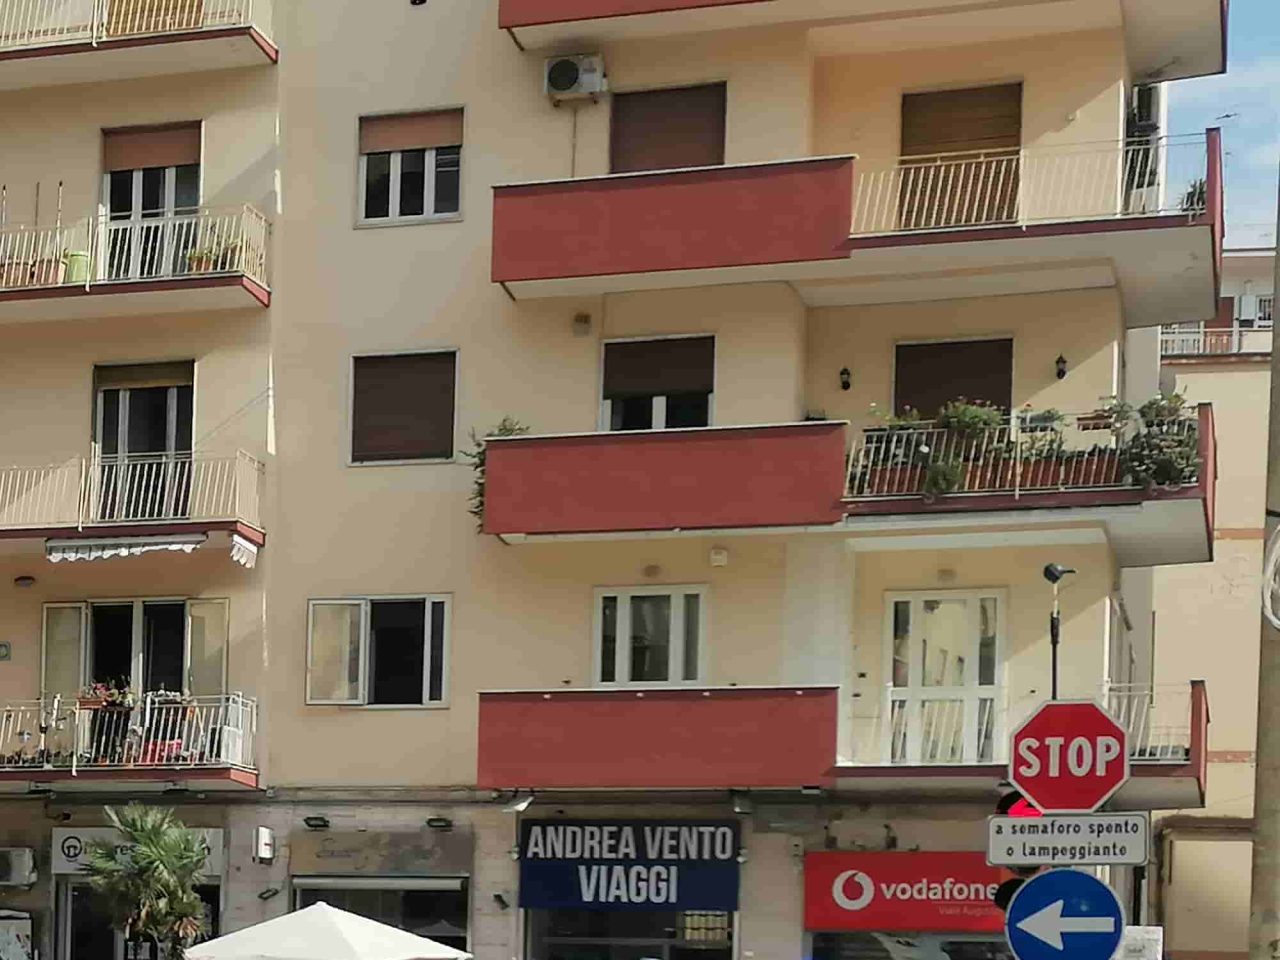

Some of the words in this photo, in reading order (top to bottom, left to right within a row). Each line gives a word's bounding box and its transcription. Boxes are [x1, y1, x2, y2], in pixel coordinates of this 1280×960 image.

[1018, 736, 1120, 777] STOP
[526, 826, 636, 859] ANDREA
[644, 826, 733, 860] VENTO
[995, 825, 1003, 835] a
[1011, 820, 1081, 835] semaforo
[1089, 820, 1139, 838] spento
[1006, 847, 1014, 857] o
[1022, 842, 1127, 860] lampeggiante
[578, 865, 677, 903] VIAGGI
[881, 878, 998, 900] vodafone
